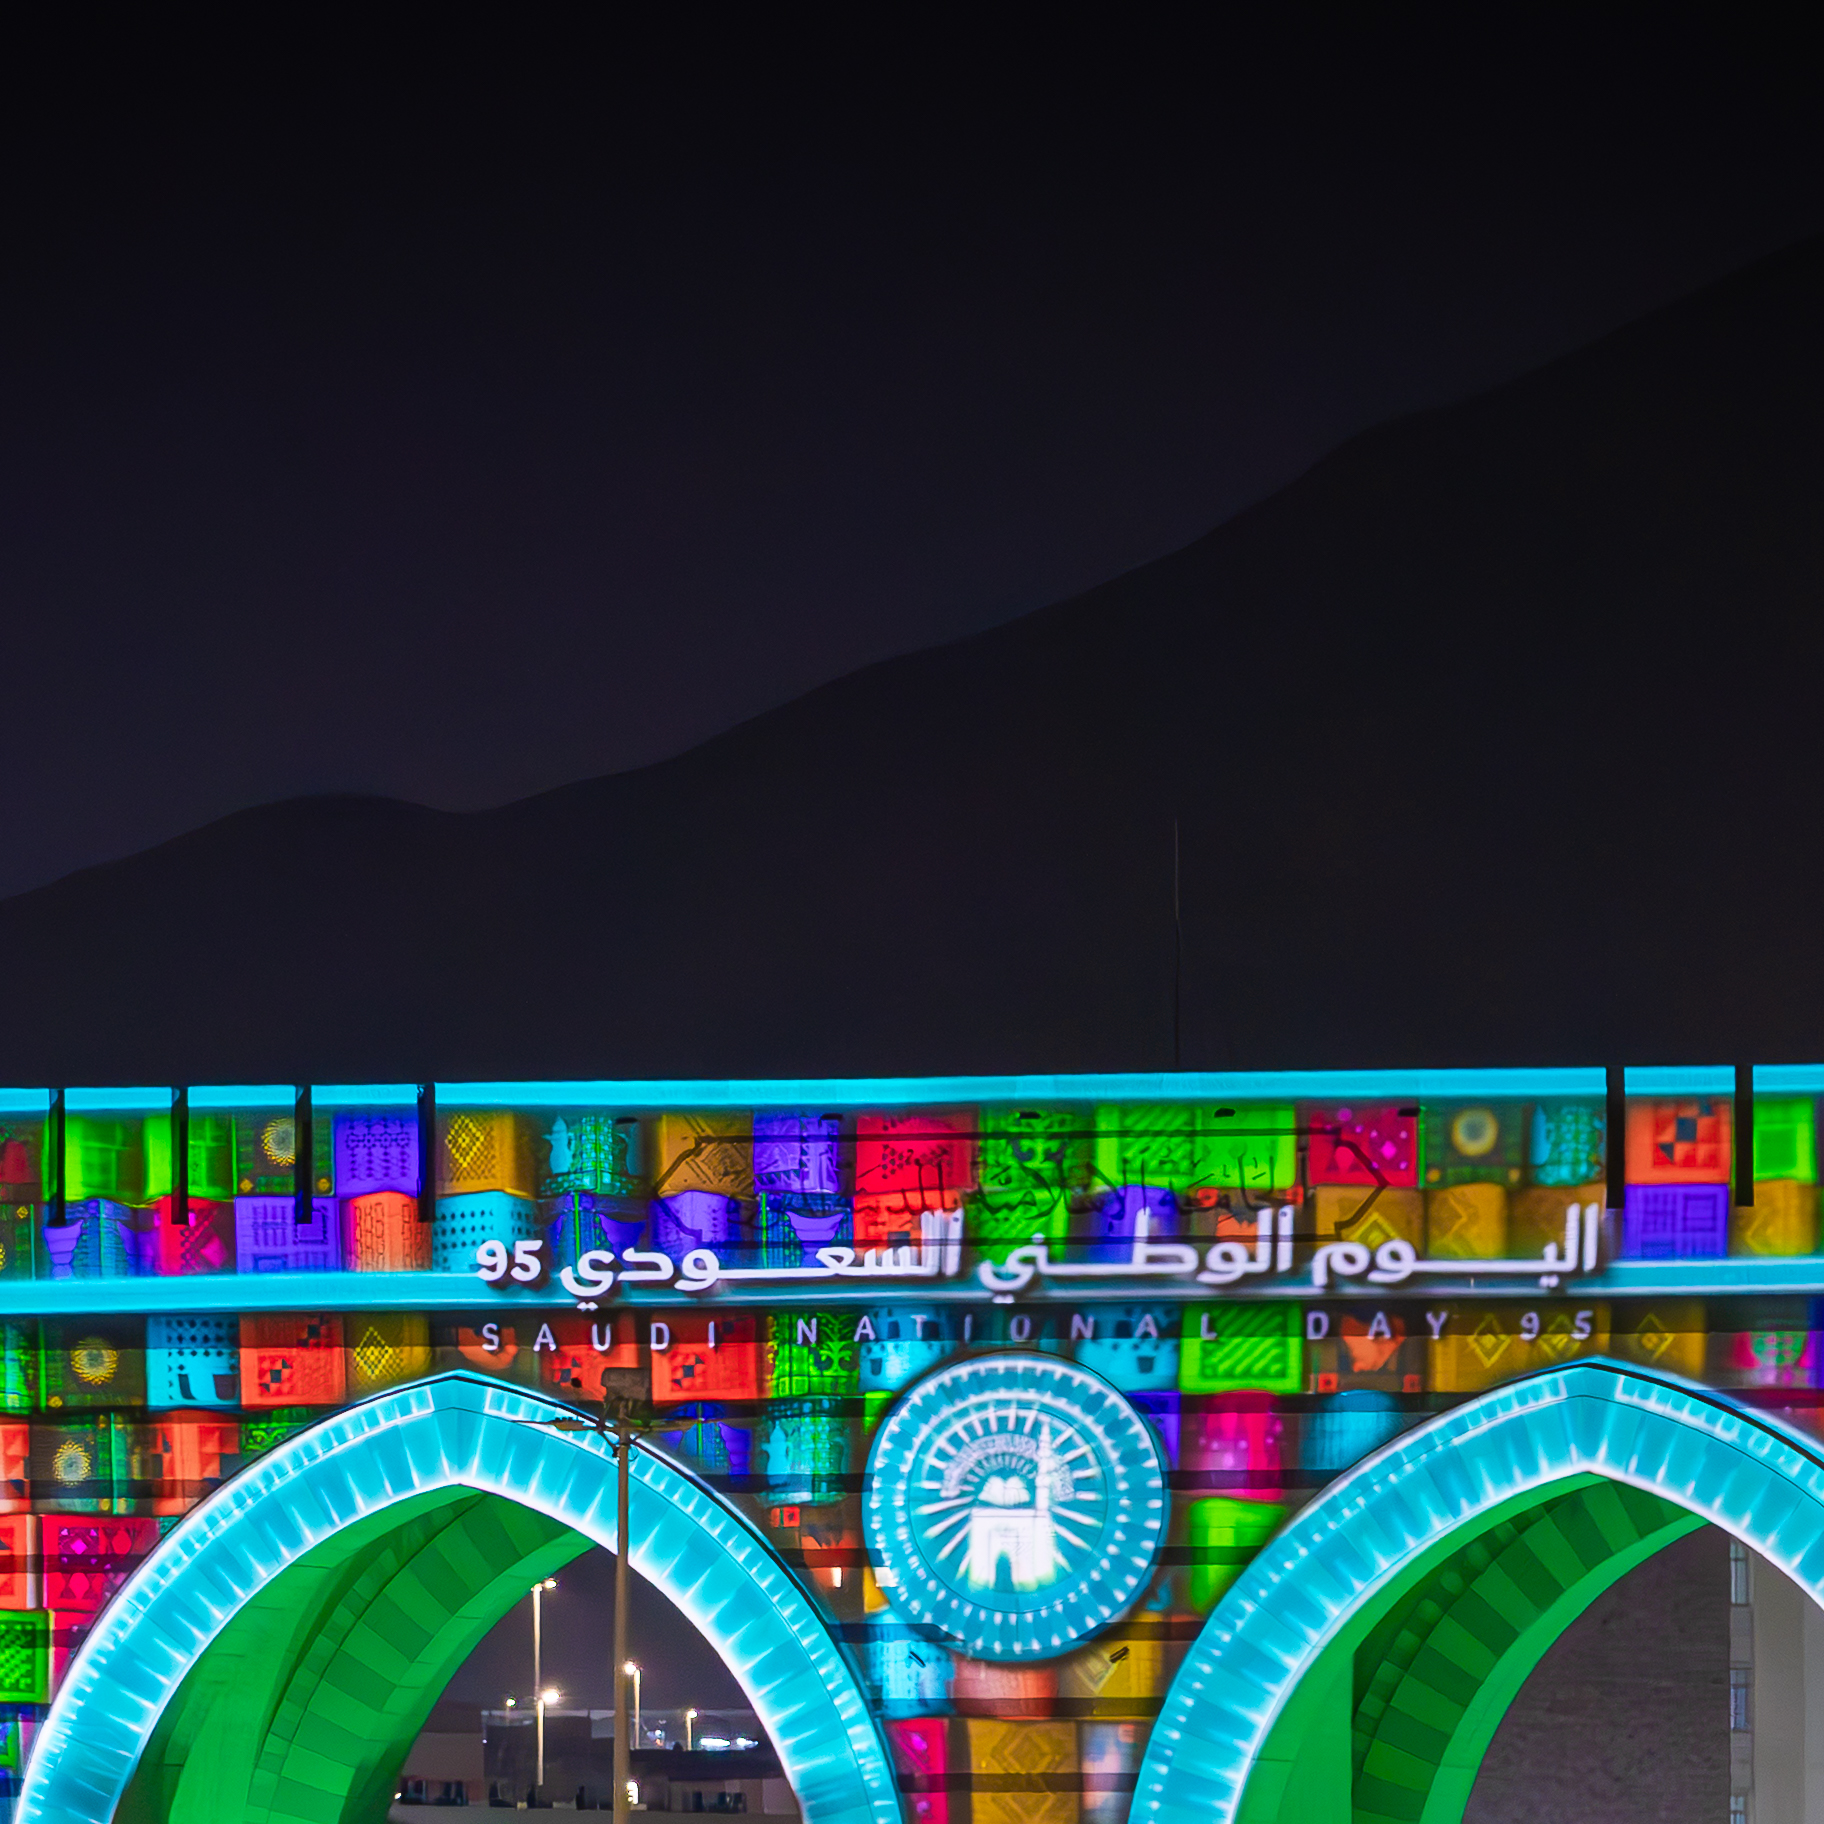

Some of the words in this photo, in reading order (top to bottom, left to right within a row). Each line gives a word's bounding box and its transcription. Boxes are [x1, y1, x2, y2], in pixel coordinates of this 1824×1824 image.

[476, 1240, 543, 1283] 95
[560, 1208, 964, 1310] السعودي
[978, 1205, 1295, 1304] الوطني
[1311, 1203, 1598, 1288] اليوم
[481, 1321, 717, 1353] SAUDI
[796, 1313, 1217, 1345] NATIONAL
[1306, 1310, 1449, 1340] DAY
[1519, 1310, 1594, 1341] 95
